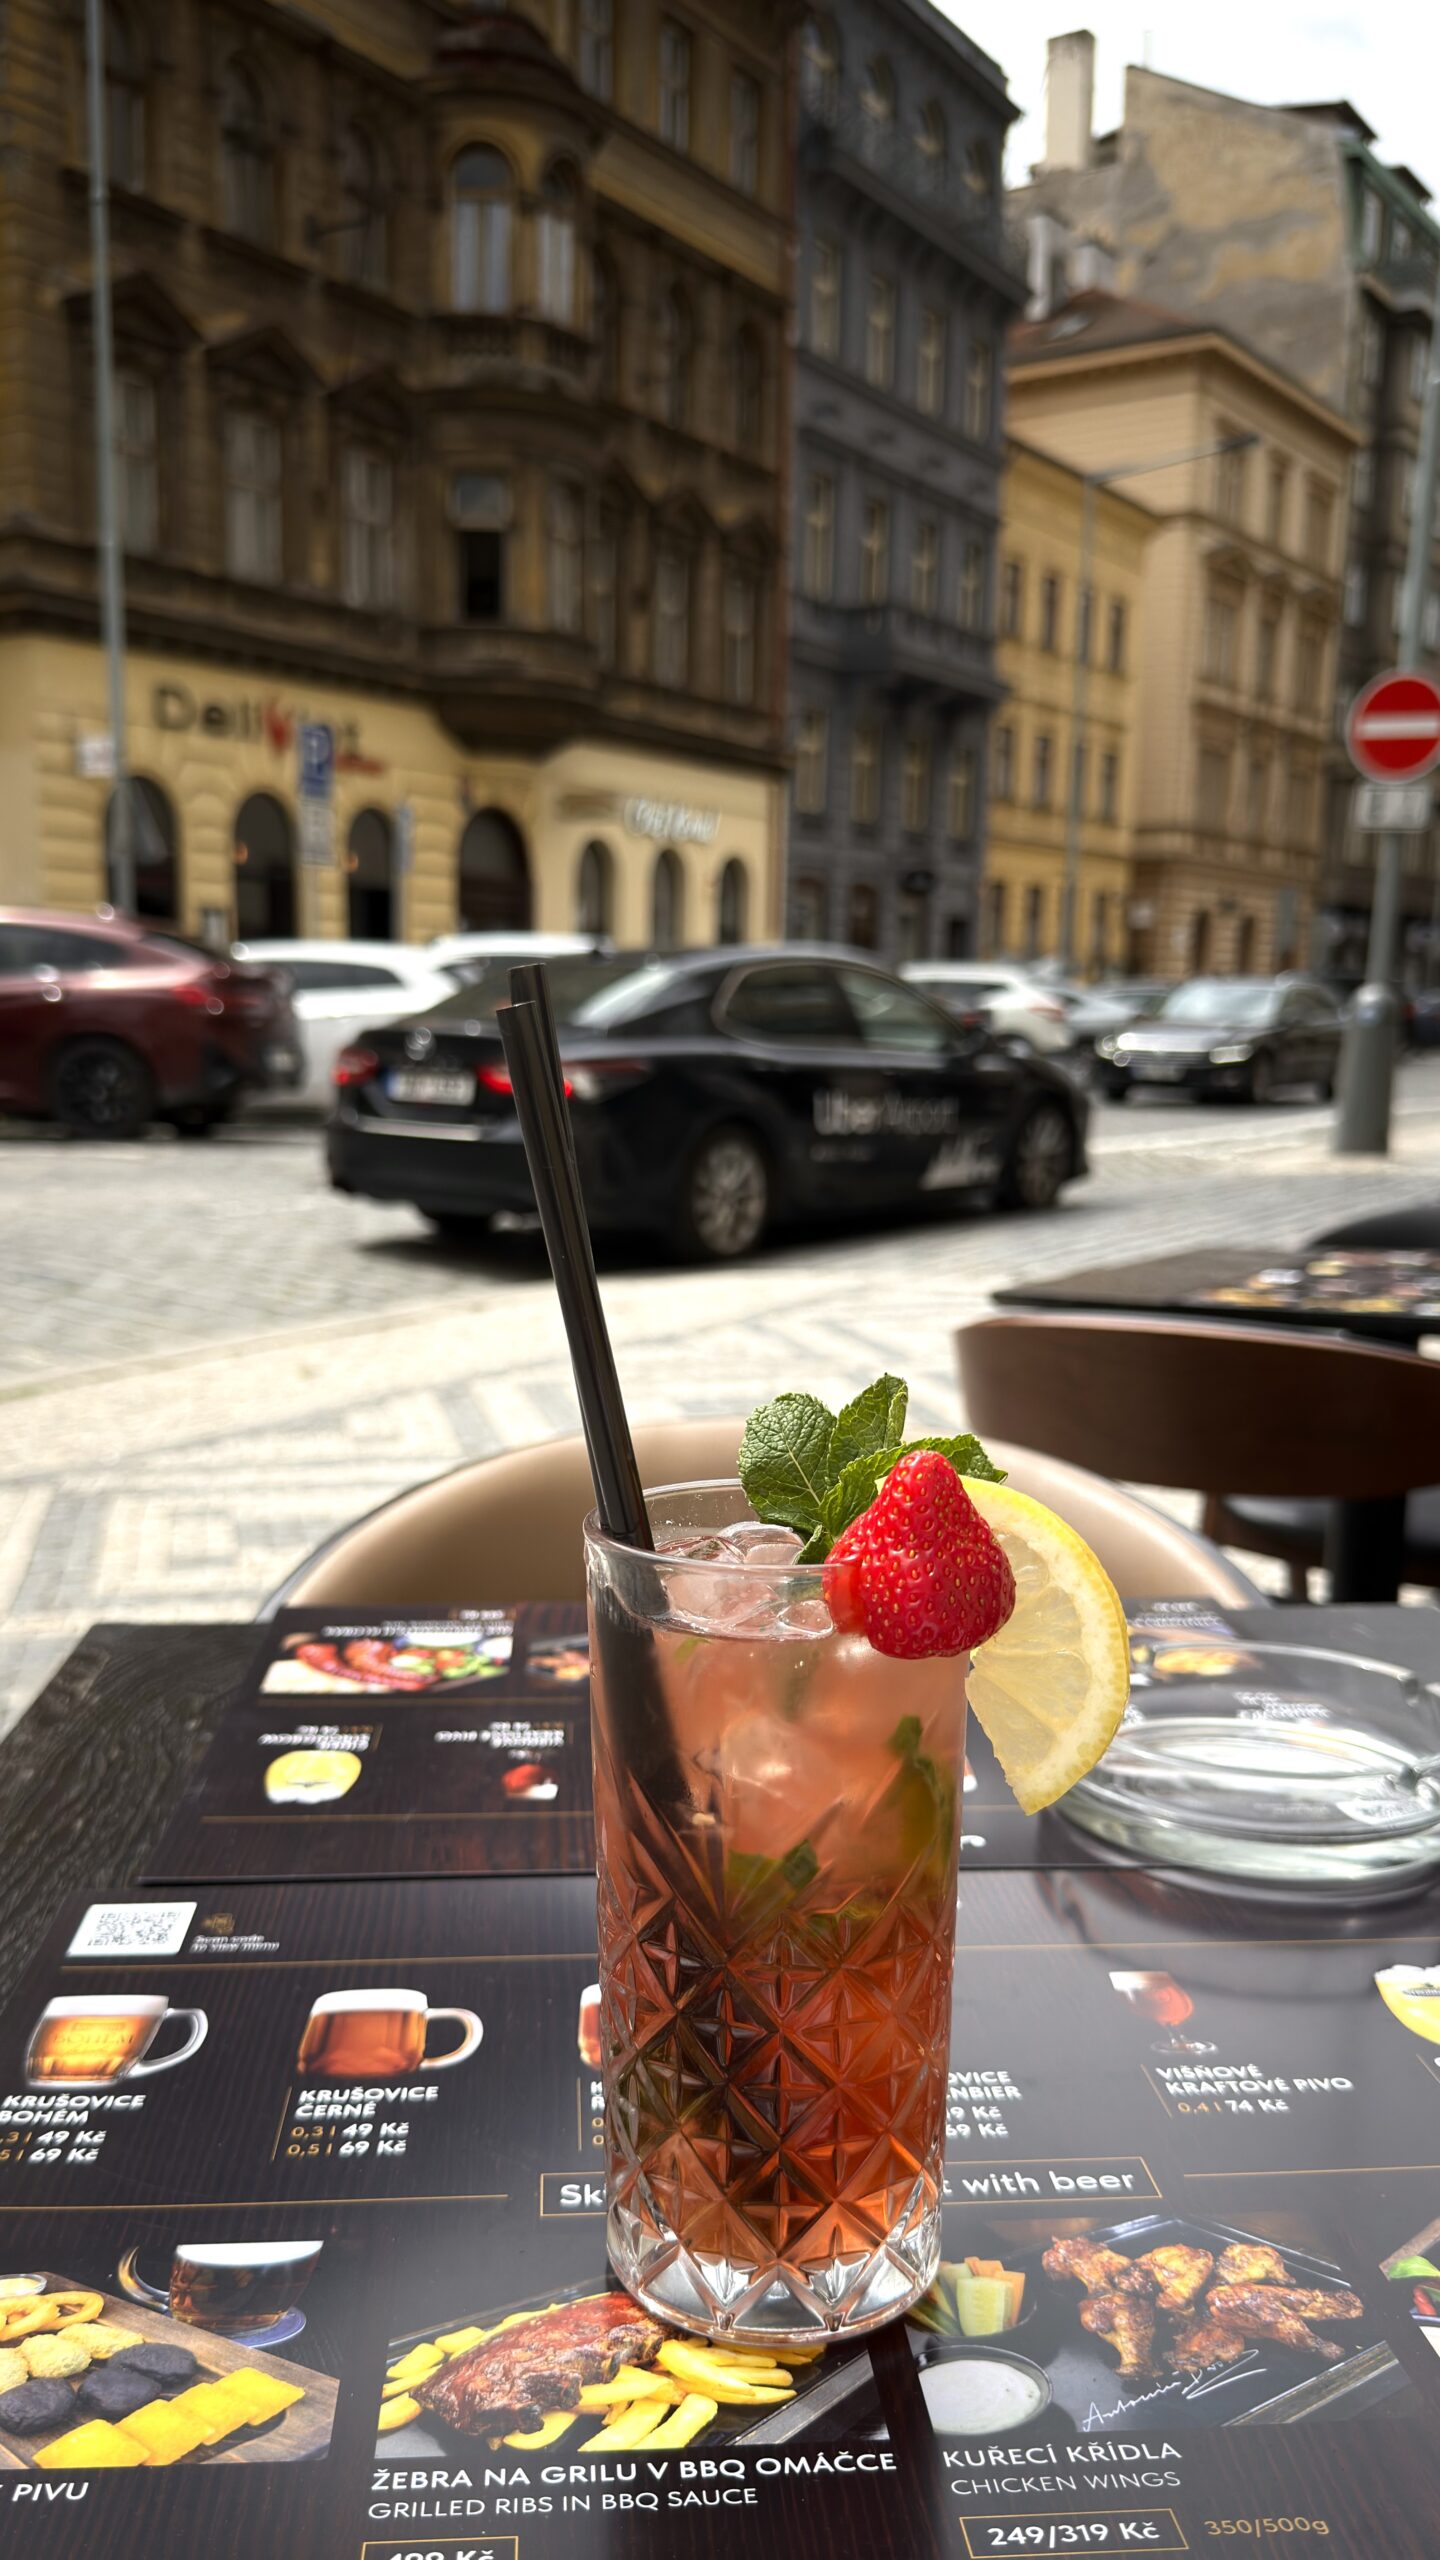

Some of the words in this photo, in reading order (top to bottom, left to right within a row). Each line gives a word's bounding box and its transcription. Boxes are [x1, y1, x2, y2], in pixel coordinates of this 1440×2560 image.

[1156, 2064, 1264, 2081] VIŠŇOVÉ
[1165, 2078, 1290, 2096] KRAFTOVÉ
[1294, 2077, 1354, 2091] PIVO
[1, 2093, 146, 2109] KRUŠOVICE
[299, 2087, 438, 2104] KRUŠOVICE
[295, 2102, 376, 2119] ČERNÉ
[971, 2106, 1002, 2119] Kč
[1225, 2100, 1254, 2113] 74
[1258, 2099, 1289, 2112] Kč
[0, 2109, 89, 2125] BOHÉM
[36, 2130, 70, 2145] 49
[74, 2130, 107, 2144] Kč
[290, 2126, 323, 2138] 0,3
[340, 2123, 373, 2137] 49
[378, 2122, 409, 2137] Kč
[978, 2123, 1008, 2137] Kč
[28, 2148, 62, 2163] 69
[67, 2147, 100, 2162] Kč
[287, 2144, 320, 2157] 0,5
[338, 2141, 370, 2157] 69
[375, 2140, 407, 2156] Kč
[962, 2172, 1040, 2195] with
[1049, 2170, 1134, 2191] beer
[942, 2444, 1057, 2467] KUŘECÍ
[1066, 2441, 1182, 2464] KŘÍDLA
[370, 2468, 473, 2491] ŽEBRA
[484, 2467, 531, 2487] NA
[540, 2463, 637, 2484] GRILU
[647, 2462, 669, 2480] V
[679, 2459, 746, 2480] BBQ
[755, 2450, 897, 2475] OMÁČCE
[950, 2475, 1076, 2495] CHICKEN
[1083, 2471, 1181, 2489] WINGS
[11, 2482, 89, 2502] PIVU
[368, 2499, 486, 2520] GRILLED
[495, 2496, 553, 2515] RIBS
[563, 2495, 590, 2512] IN
[602, 2491, 659, 2511] BBQ
[667, 2487, 758, 2508] SAUCE
[986, 2525, 1108, 2549] 249/319
[1119, 2521, 1160, 2540] Kč
[1204, 2516, 1330, 2538] 350/500g
